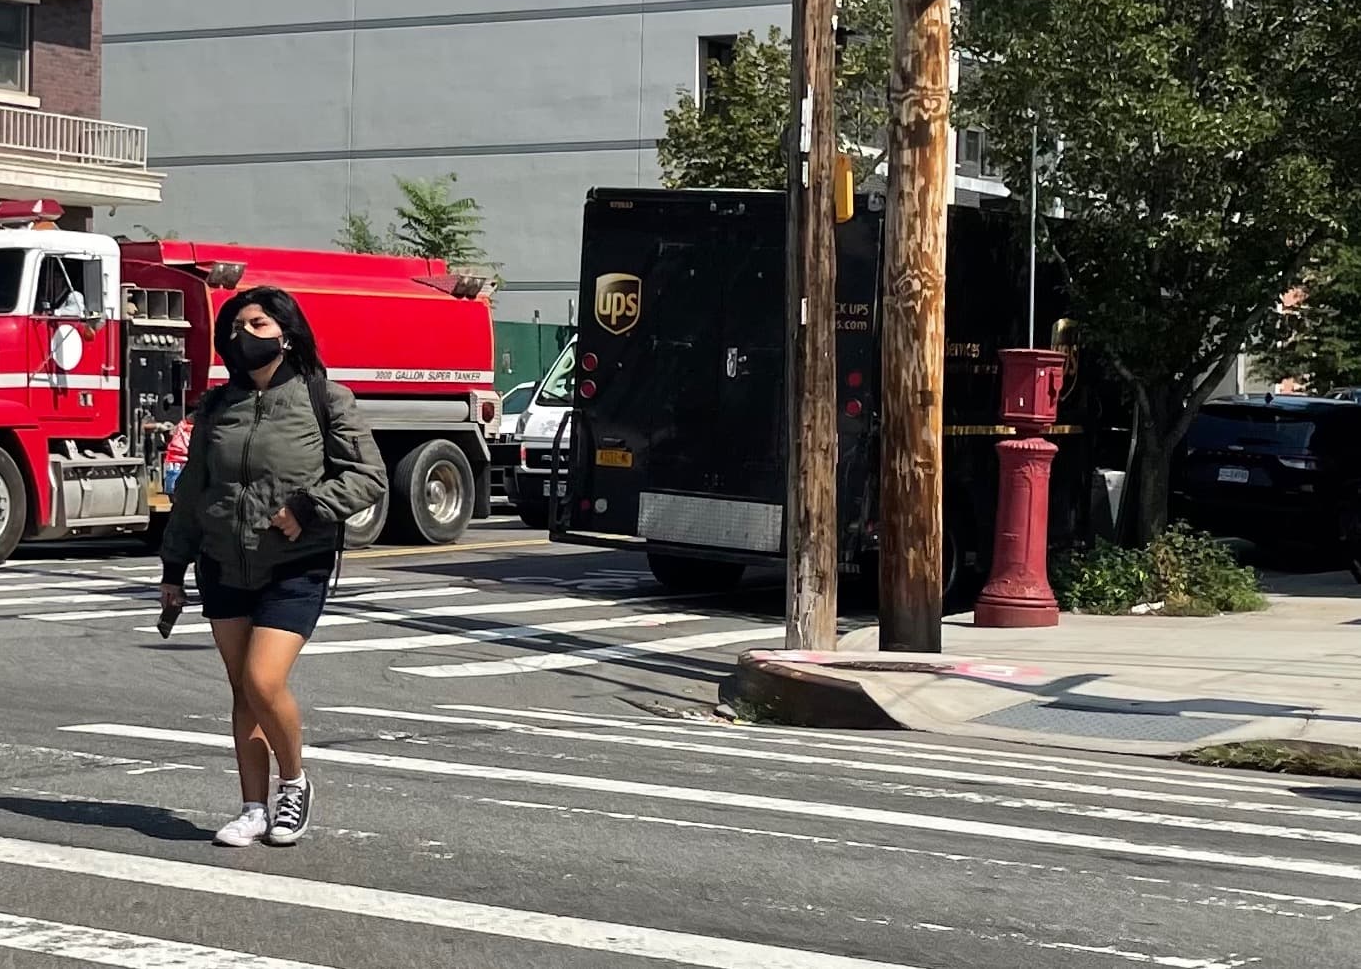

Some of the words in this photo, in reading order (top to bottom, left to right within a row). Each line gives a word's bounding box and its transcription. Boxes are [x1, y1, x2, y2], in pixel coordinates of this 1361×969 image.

[597, 292, 638, 325] ups
[849, 303, 869, 316] UPS
[395, 371, 424, 380] GALLON
[427, 372, 451, 381] SUPER
[454, 372, 481, 381] TANKER
